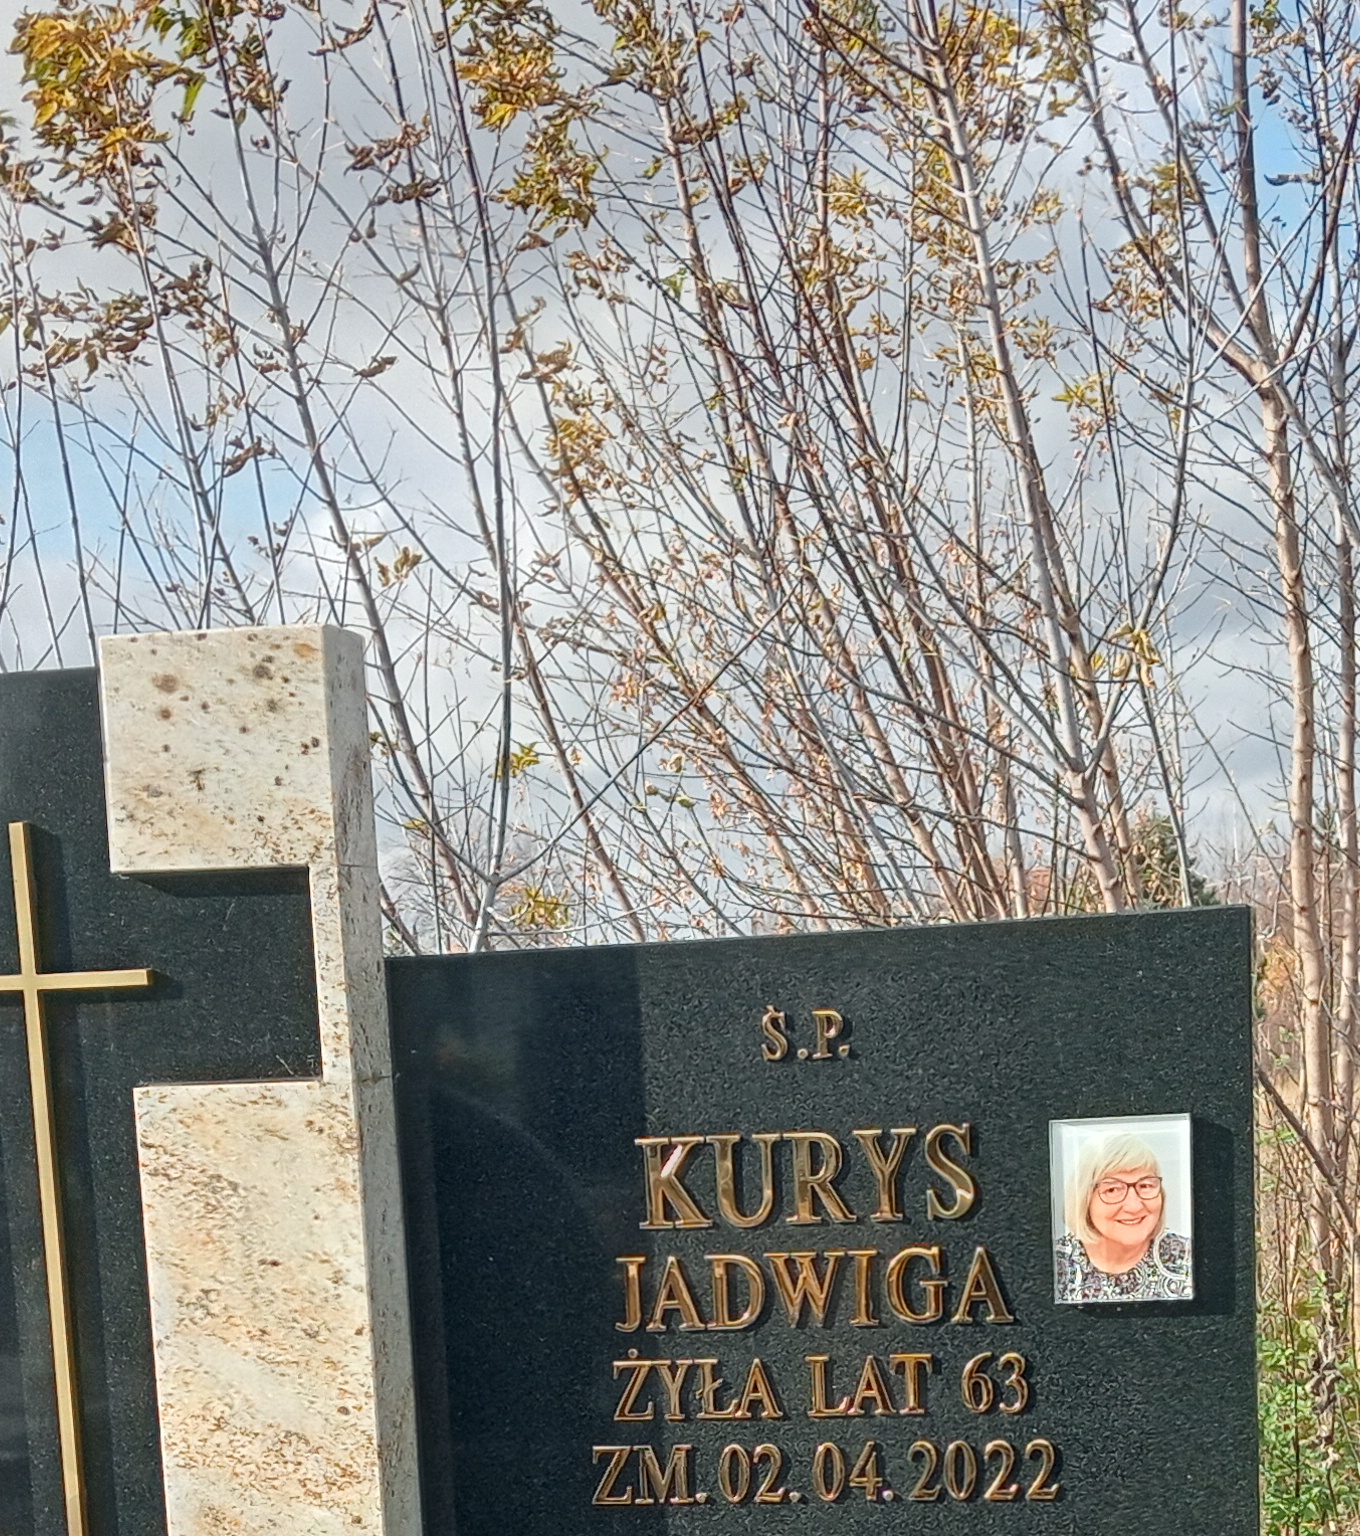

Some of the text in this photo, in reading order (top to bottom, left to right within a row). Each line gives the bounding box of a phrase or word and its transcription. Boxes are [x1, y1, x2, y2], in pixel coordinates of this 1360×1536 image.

[634, 1121, 976, 1231] KURYS
[614, 1244, 1015, 1333] JADWIGA
[611, 1348, 1030, 1422] ŻYŁA LAT 63
